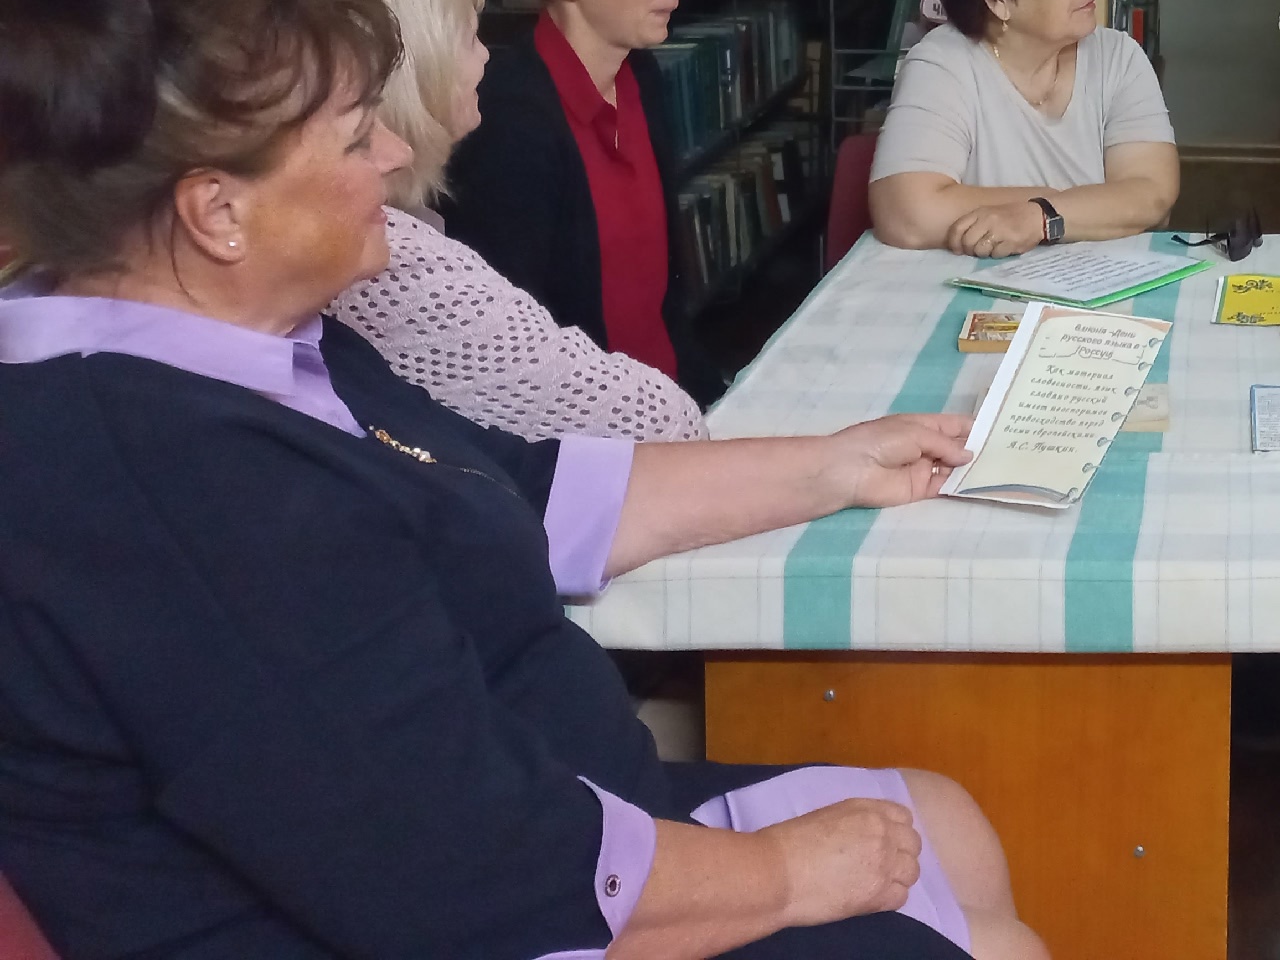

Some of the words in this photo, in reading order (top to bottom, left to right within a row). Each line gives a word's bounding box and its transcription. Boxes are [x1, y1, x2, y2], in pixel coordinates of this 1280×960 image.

[1060, 333, 1103, 345] русского
[1104, 339, 1133, 349] языка
[1079, 346, 1114, 358] России
[1045, 364, 1065, 376] Как
[1066, 369, 1114, 381] материал
[1093, 385, 1117, 394] язык
[1069, 395, 1108, 405] русский
[1018, 401, 1048, 411] имеет
[1078, 419, 1105, 429] перед
[1003, 424, 1030, 435] всеми
